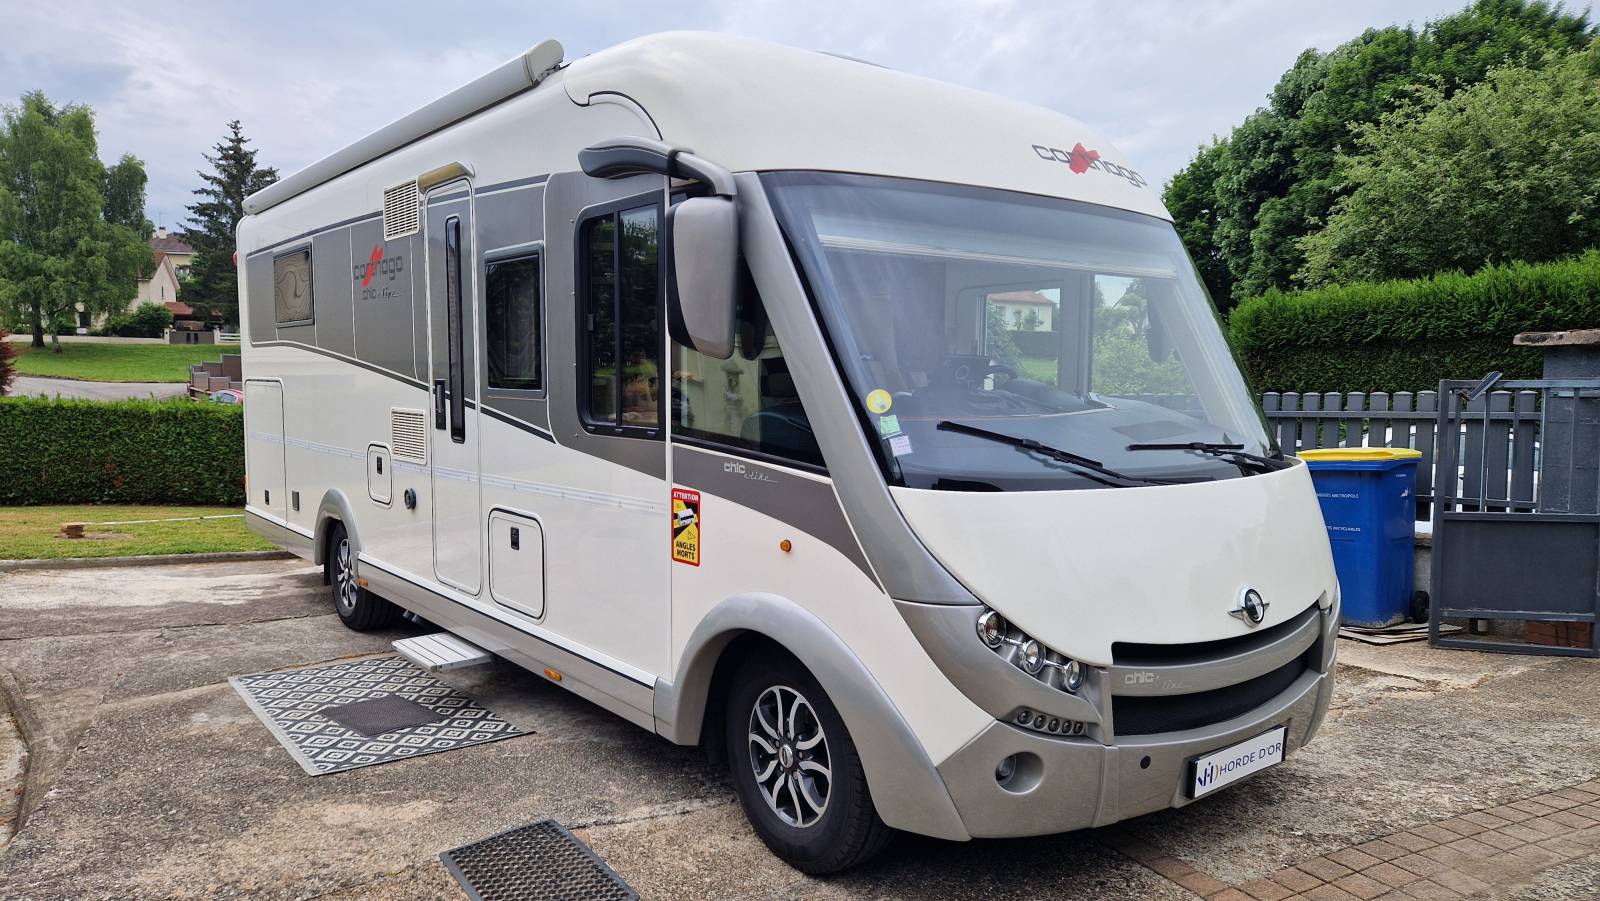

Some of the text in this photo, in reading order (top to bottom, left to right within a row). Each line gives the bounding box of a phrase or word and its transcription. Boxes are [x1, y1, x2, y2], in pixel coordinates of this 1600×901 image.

[1031, 144, 1148, 188] cahago
[723, 461, 746, 474] chic
[673, 491, 699, 502] ATTENTION
[675, 540, 696, 552] ANGLES
[676, 549, 695, 560] MORTS
[1124, 671, 1154, 685] chic
[1219, 742, 1283, 776] HORDE D'OR
